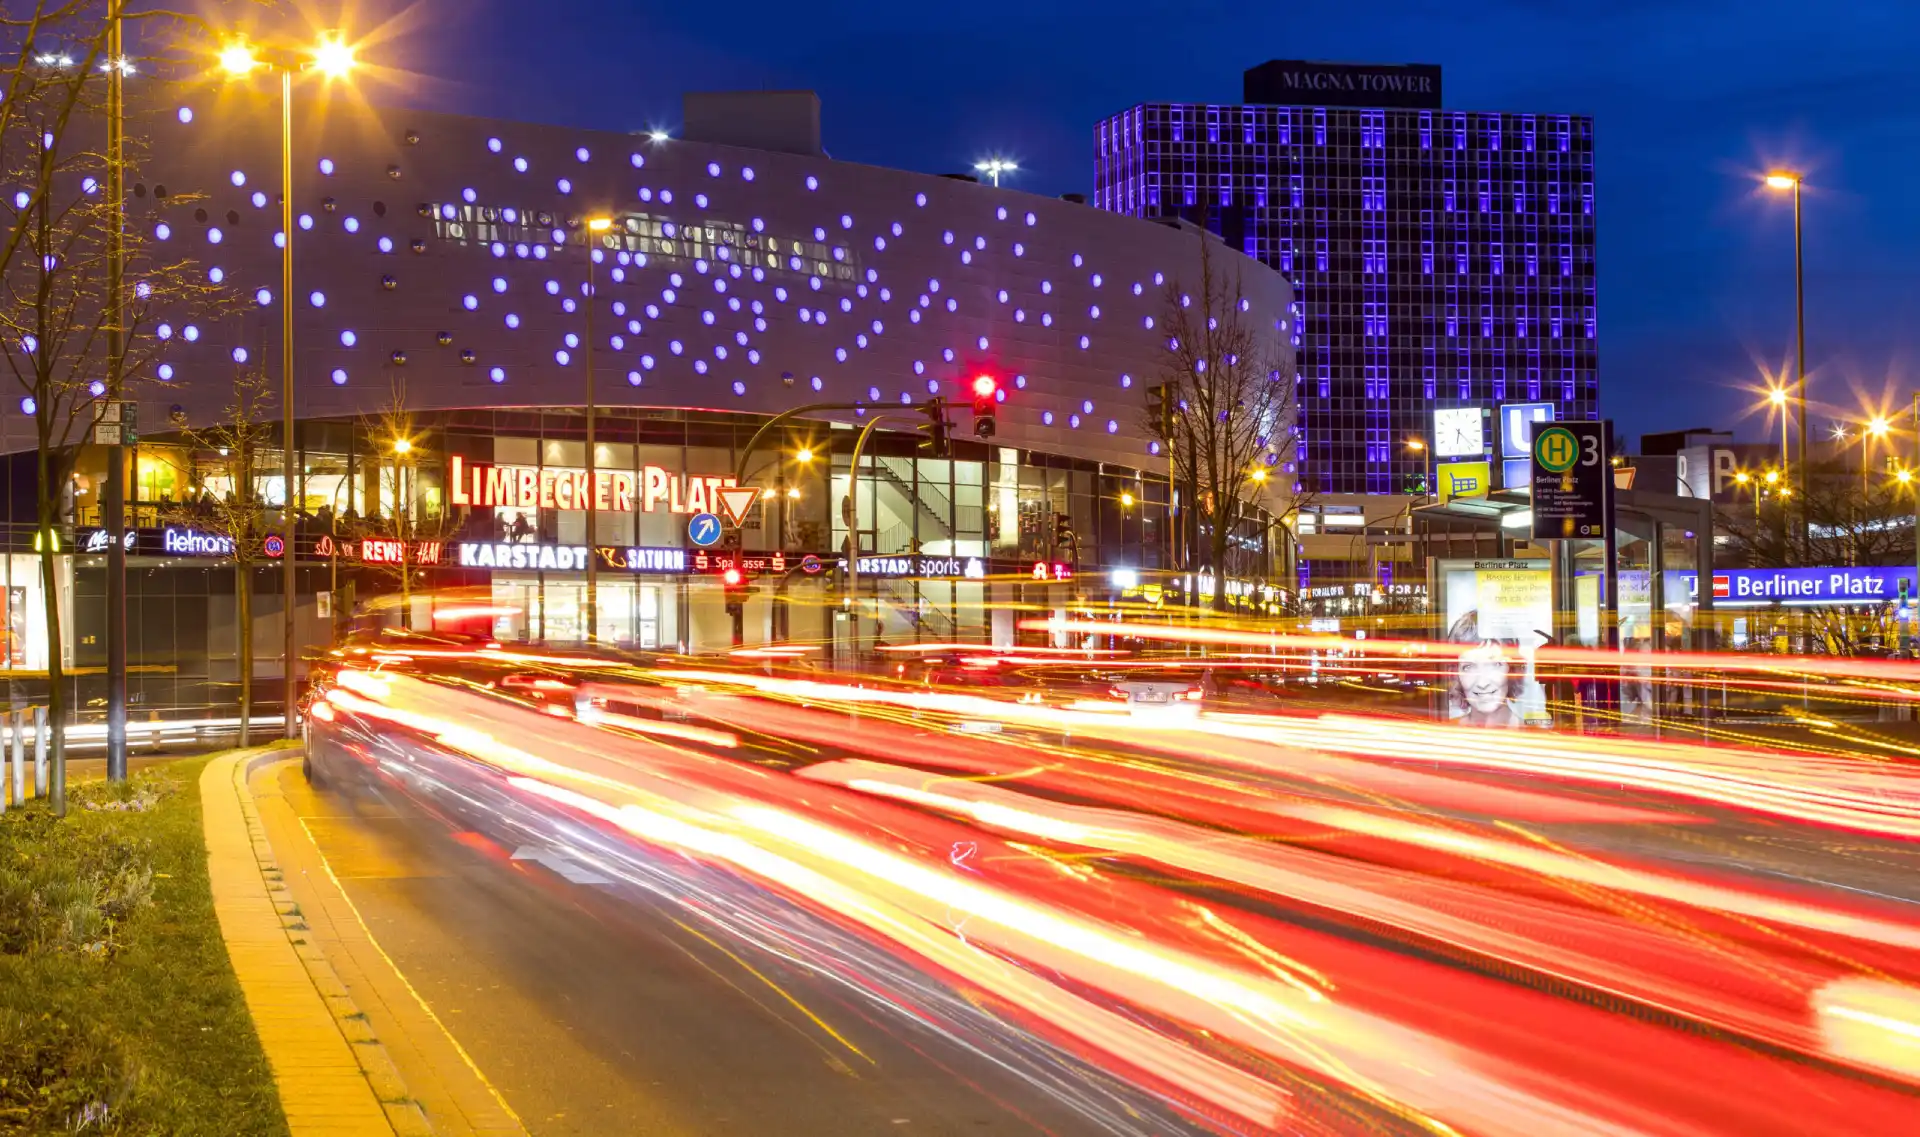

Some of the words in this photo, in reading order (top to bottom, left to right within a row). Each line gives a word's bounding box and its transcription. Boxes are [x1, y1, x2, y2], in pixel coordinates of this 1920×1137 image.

[1283, 71, 1355, 90] MAGNA
[1359, 74, 1432, 92] TOWER
[1549, 437, 1566, 462] H
[1582, 435, 1599, 467] 3
[1536, 476, 1561, 484] Berliner
[1713, 449, 1737, 494] P
[452, 456, 633, 511] LIMBECKER
[460, 543, 588, 569] KARSTADT
[627, 549, 684, 570] SATURN
[715, 556, 765, 570] Spaasse
[1474, 561, 1507, 569] Berliner
[1508, 561, 1529, 569] Platz
[920, 557, 960, 578] sports
[1414, 585, 1427, 595] AL
[1737, 574, 1824, 597] Berliner
[1830, 573, 1885, 595] Platz
